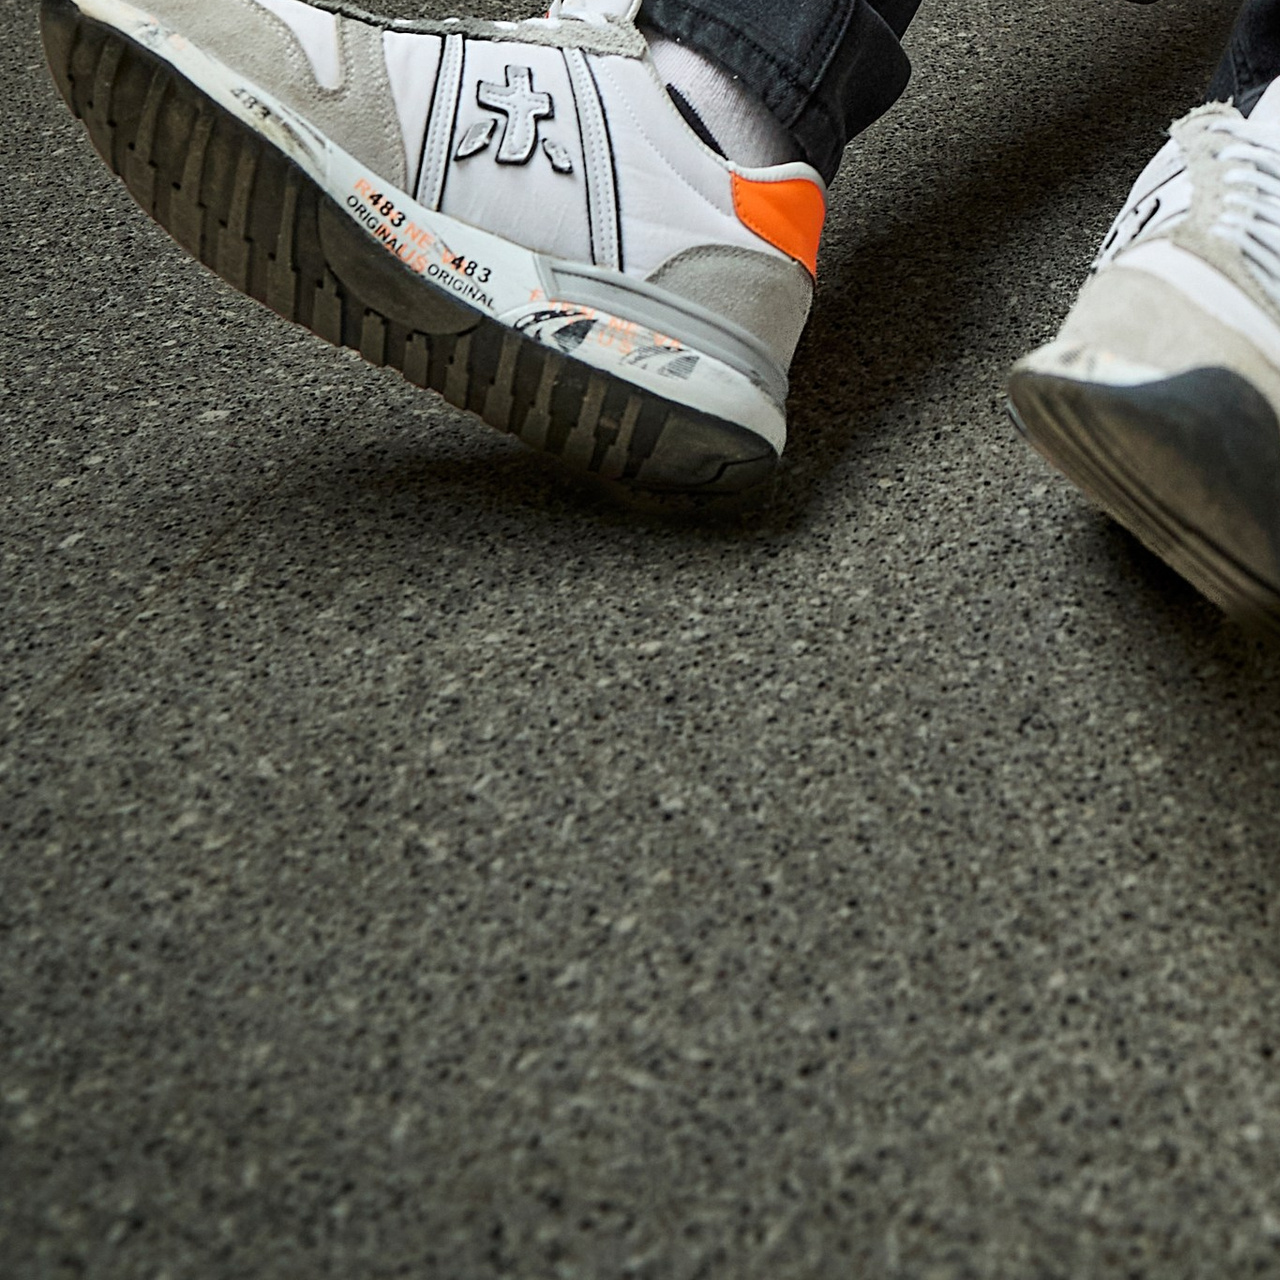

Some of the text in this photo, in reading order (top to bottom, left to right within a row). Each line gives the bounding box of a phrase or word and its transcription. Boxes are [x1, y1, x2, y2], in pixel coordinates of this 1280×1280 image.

[346, 195, 404, 257] ORIGINAL
[369, 193, 406, 228] 483
[427, 263, 496, 311] ORIGINAL
[451, 255, 492, 283] 483
